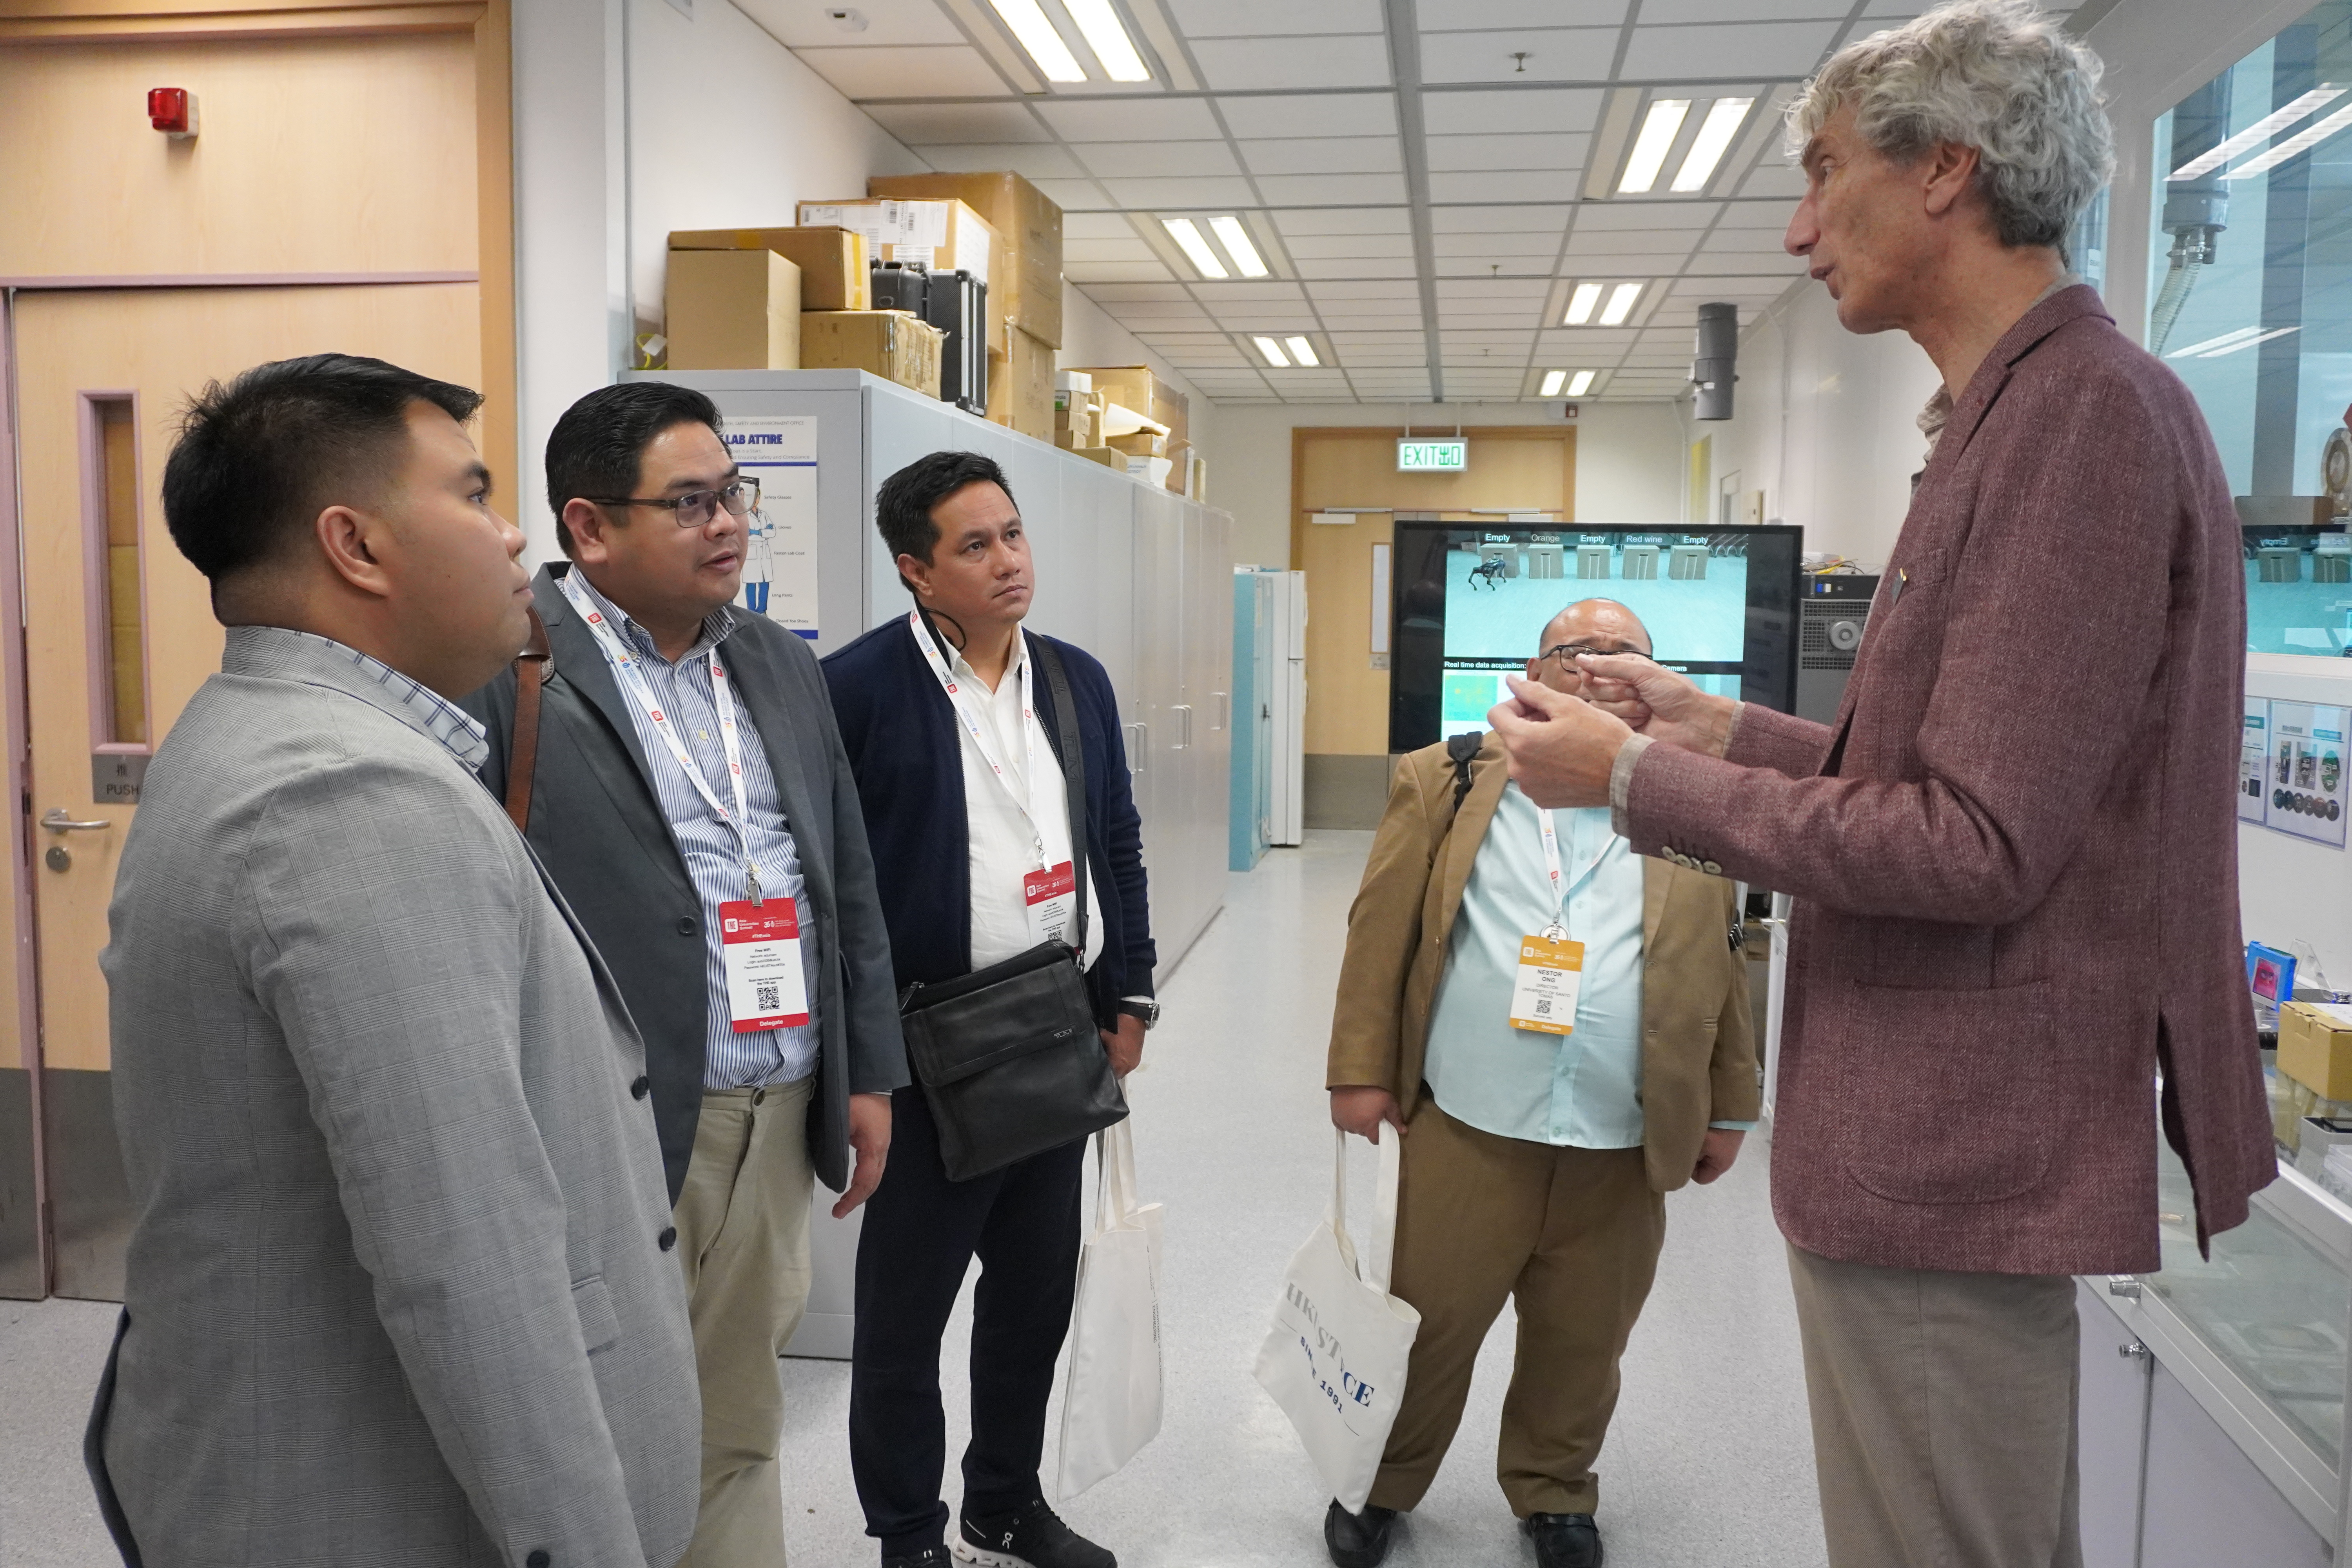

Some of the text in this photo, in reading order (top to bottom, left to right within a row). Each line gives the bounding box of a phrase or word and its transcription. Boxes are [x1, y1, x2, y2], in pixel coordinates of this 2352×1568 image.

[725, 434, 746, 444] LAB
[748, 434, 782, 444] ATTIRE
[1404, 446, 1461, 465] EXIT 出口
[1485, 534, 1510, 543] Empty
[1531, 534, 1560, 543] Orange
[1581, 534, 1606, 543] Empty
[1684, 535, 1708, 545] Empty
[590, 613, 600, 624] THE
[653, 711, 661, 720] THE
[106, 783, 139, 796] PUSH
[727, 921, 736, 929] THE
[1054, 1028, 1073, 1038] TUMI
[1320, 1380, 1343, 1414] 1991
